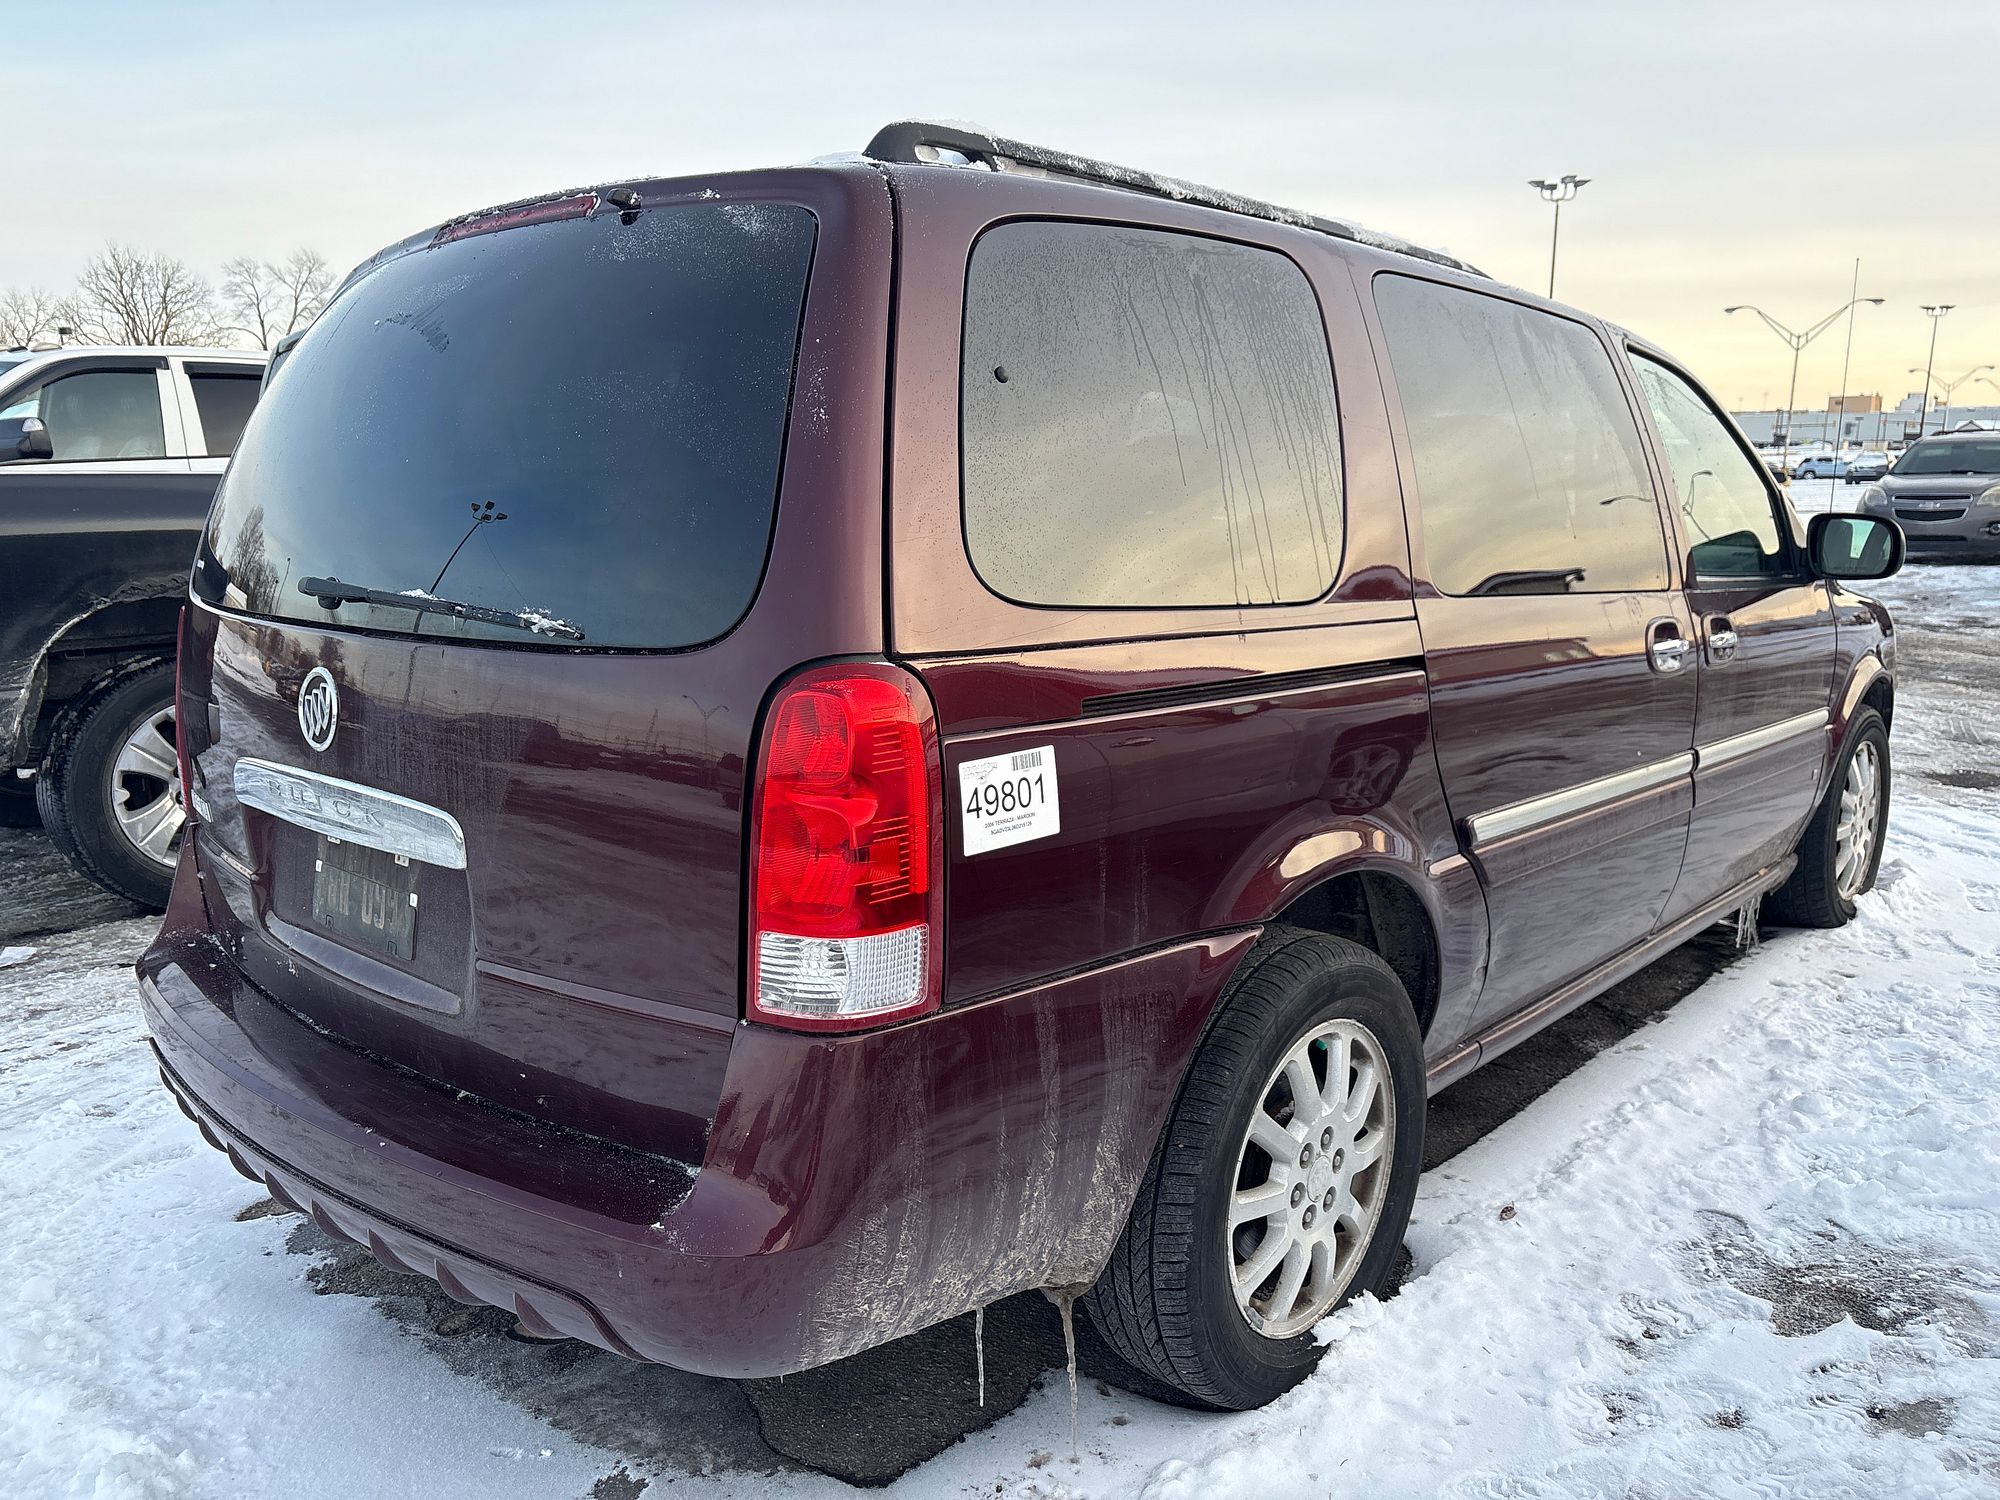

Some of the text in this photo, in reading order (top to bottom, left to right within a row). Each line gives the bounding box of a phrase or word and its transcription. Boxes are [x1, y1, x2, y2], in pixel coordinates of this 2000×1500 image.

[266, 777, 384, 828] BUICK
[967, 772, 1044, 819] 49801
[995, 817, 1014, 826] TERRAZA
[1017, 812, 1035, 820] MAROON
